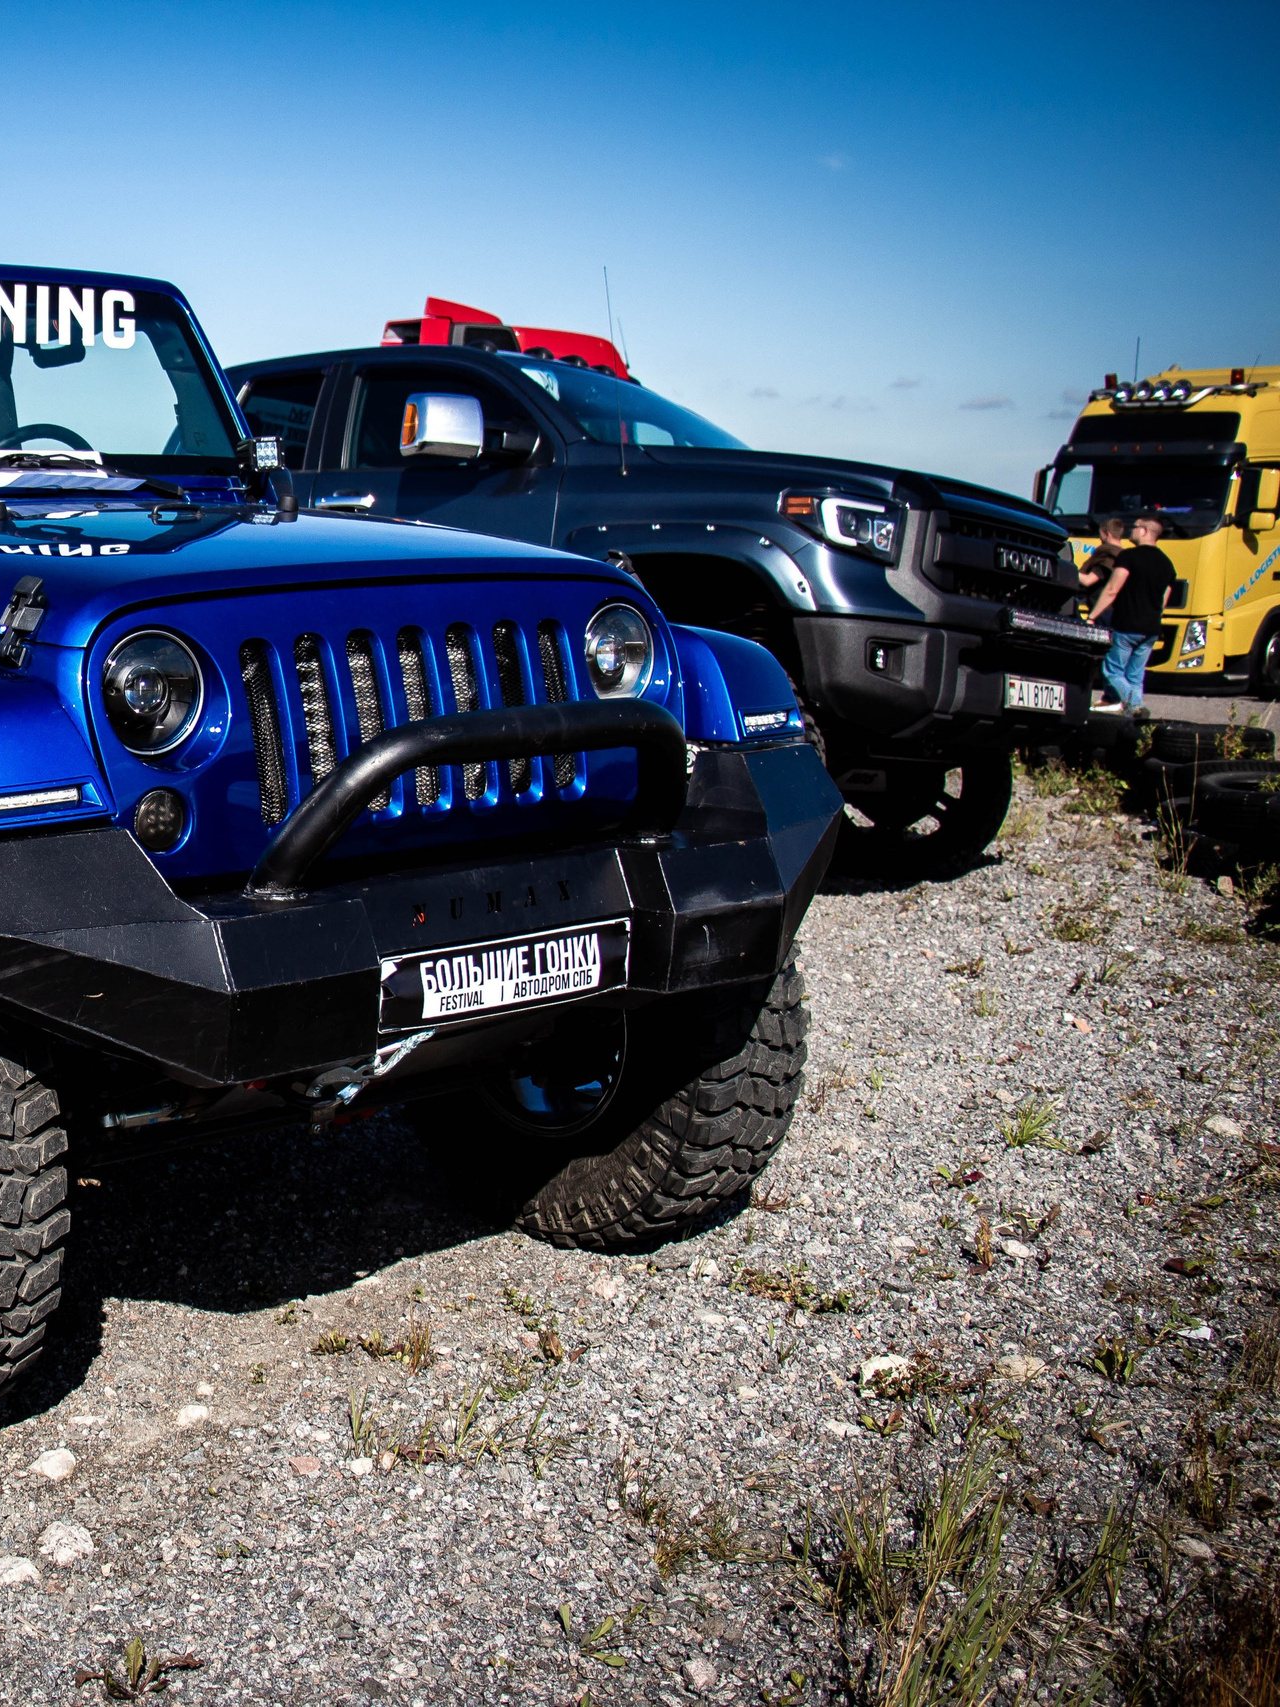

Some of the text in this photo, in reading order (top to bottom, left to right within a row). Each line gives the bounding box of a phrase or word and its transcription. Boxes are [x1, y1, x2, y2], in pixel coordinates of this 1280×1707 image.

[997, 547, 1054, 578] TOYOTA
[1017, 683, 1030, 705] AI
[1033, 684, 1064, 709] 8170-4
[412, 879, 571, 927] NUMAX
[419, 932, 602, 994] БОЛЬШИЕ ГОНКИ
[512, 968, 593, 1000] АВТОДРОМ СПБ
[439, 988, 485, 1013] FESTIVAL
